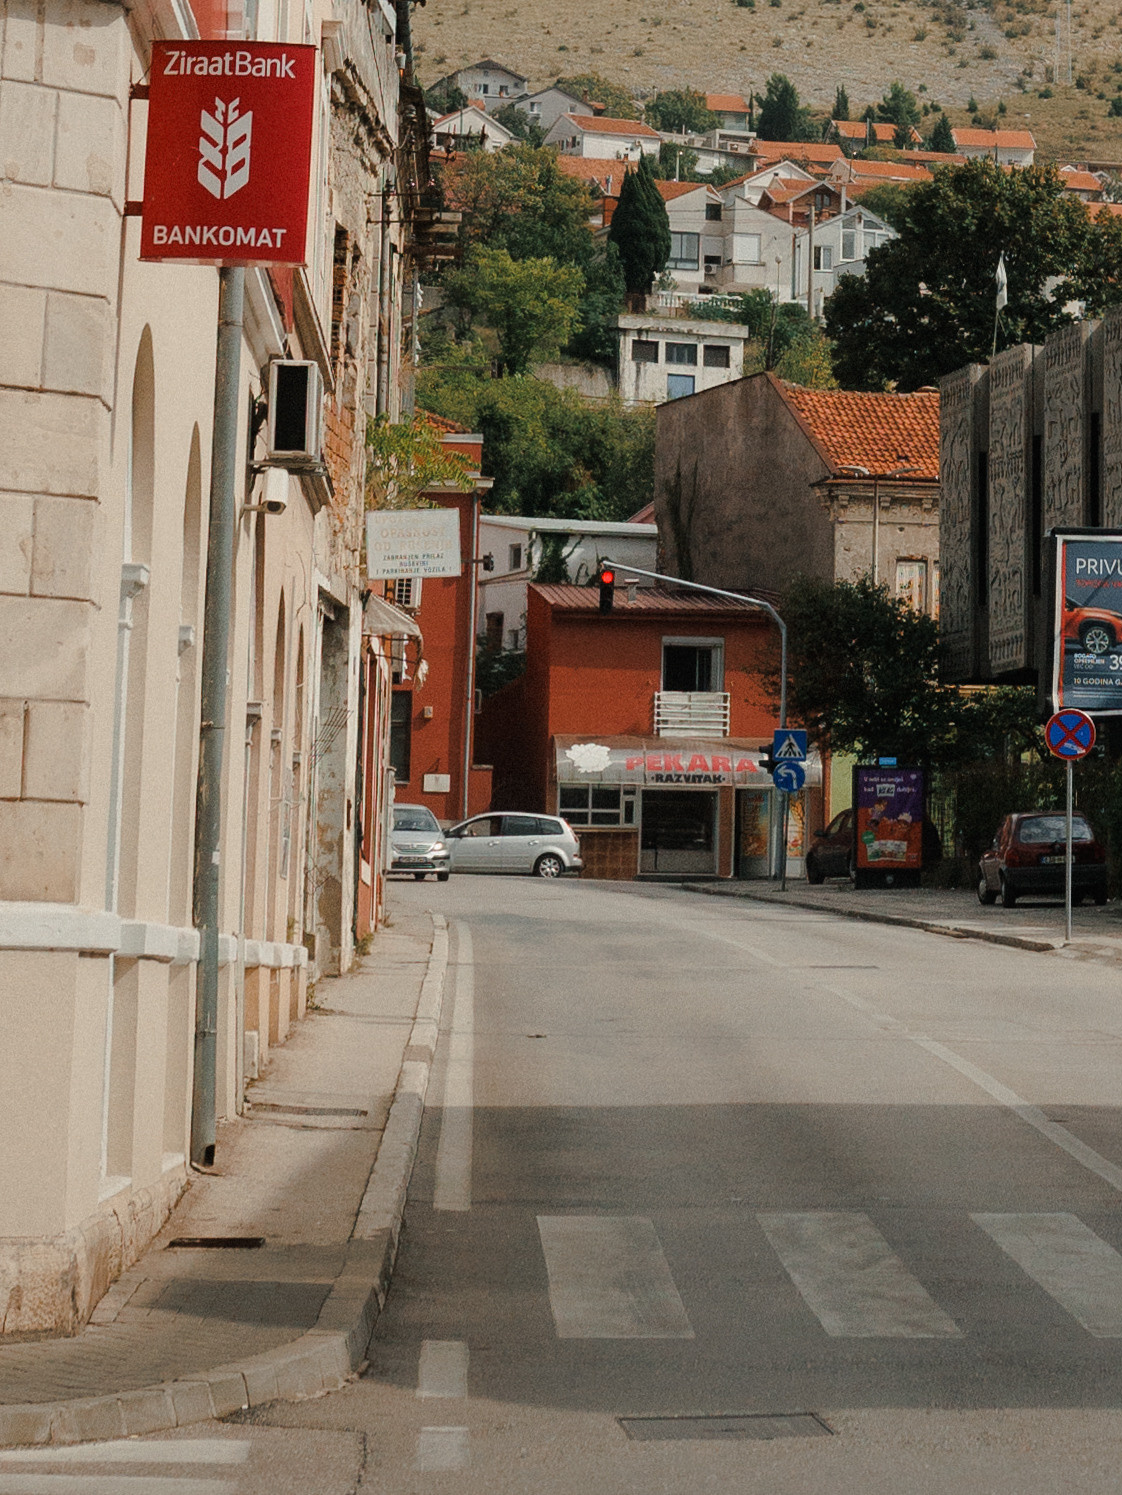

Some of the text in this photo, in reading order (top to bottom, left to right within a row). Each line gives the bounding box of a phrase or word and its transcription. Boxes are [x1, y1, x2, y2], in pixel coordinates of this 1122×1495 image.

[163, 51, 296, 79] ZiraatBank
[153, 225, 287, 248] BANKOMAT
[1083, 677, 1113, 685] GODINA
[625, 754, 758, 773] PEKARA
